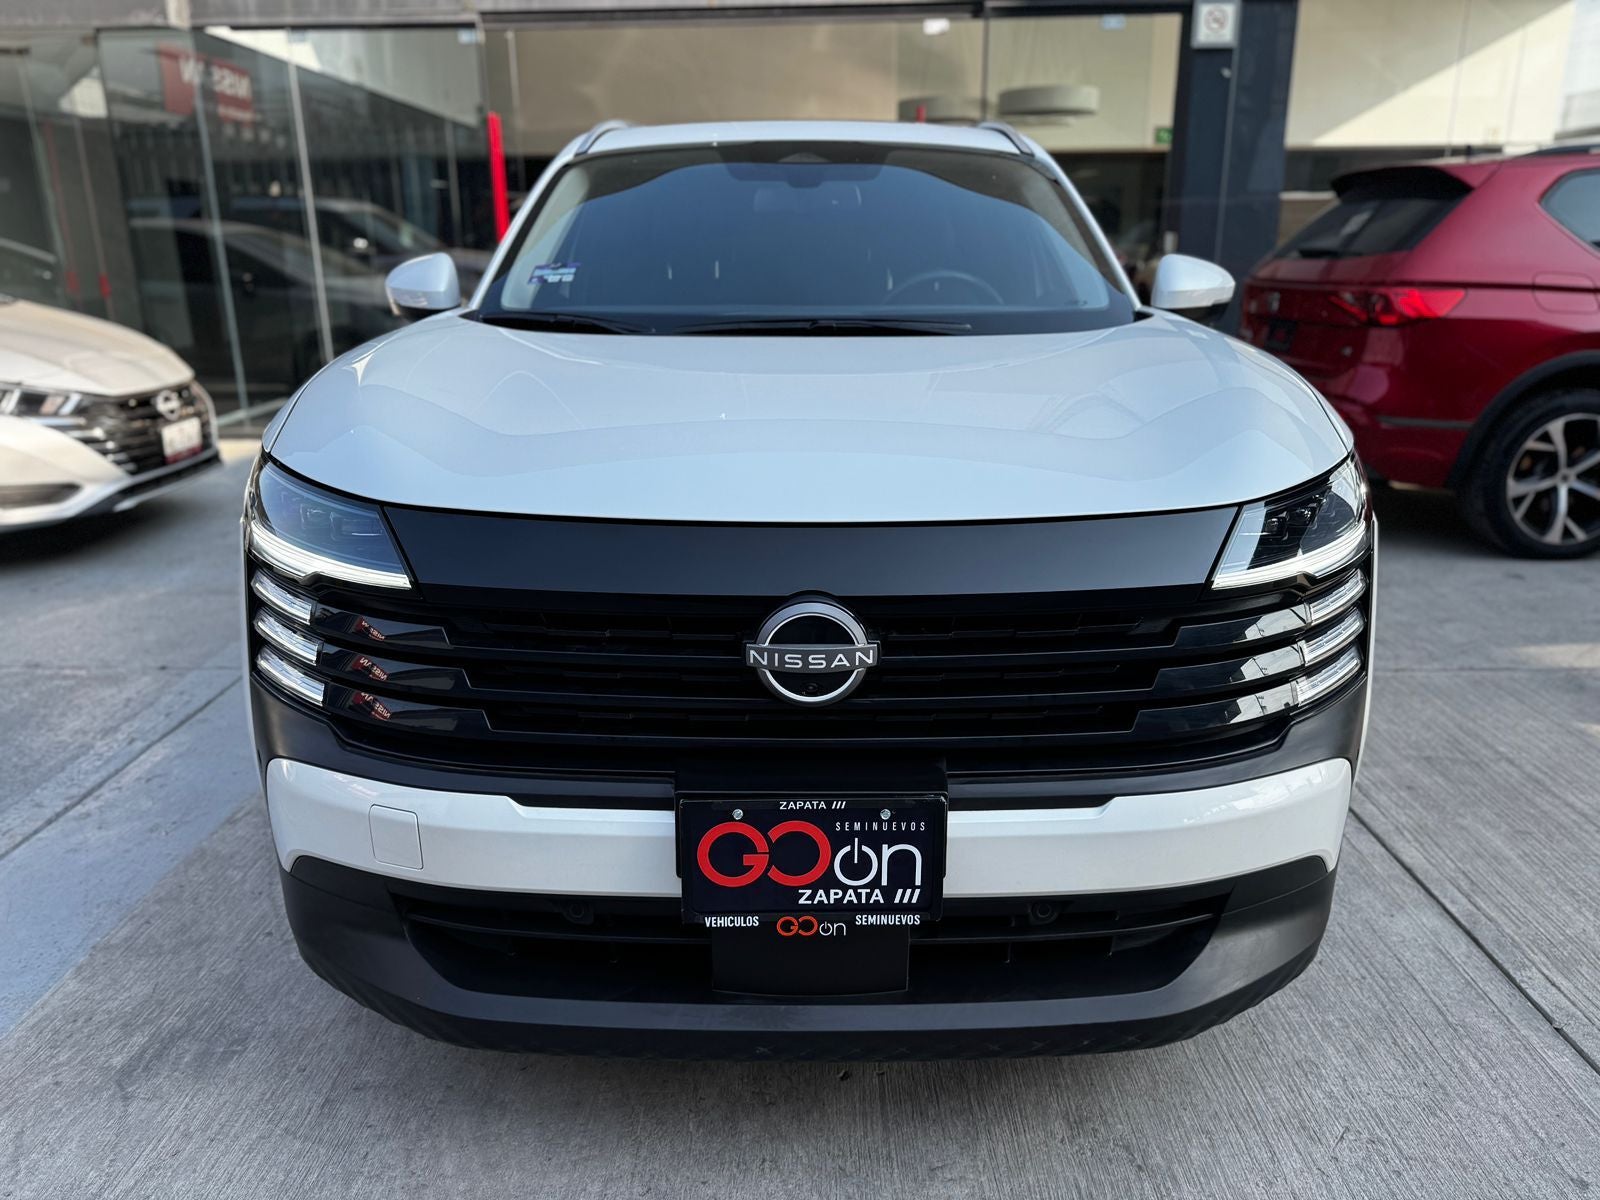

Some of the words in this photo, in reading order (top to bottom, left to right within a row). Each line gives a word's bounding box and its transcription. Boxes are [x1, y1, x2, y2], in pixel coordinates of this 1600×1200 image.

[749, 649, 874, 669] NISSAN
[779, 801, 827, 810] ZAPATA
[835, 821, 926, 832] SEMINUEVOS
[798, 888, 885, 905] ZAPATA
[704, 915, 760, 928] VEHICULOS
[855, 914, 921, 926] SEMINUEVOS
